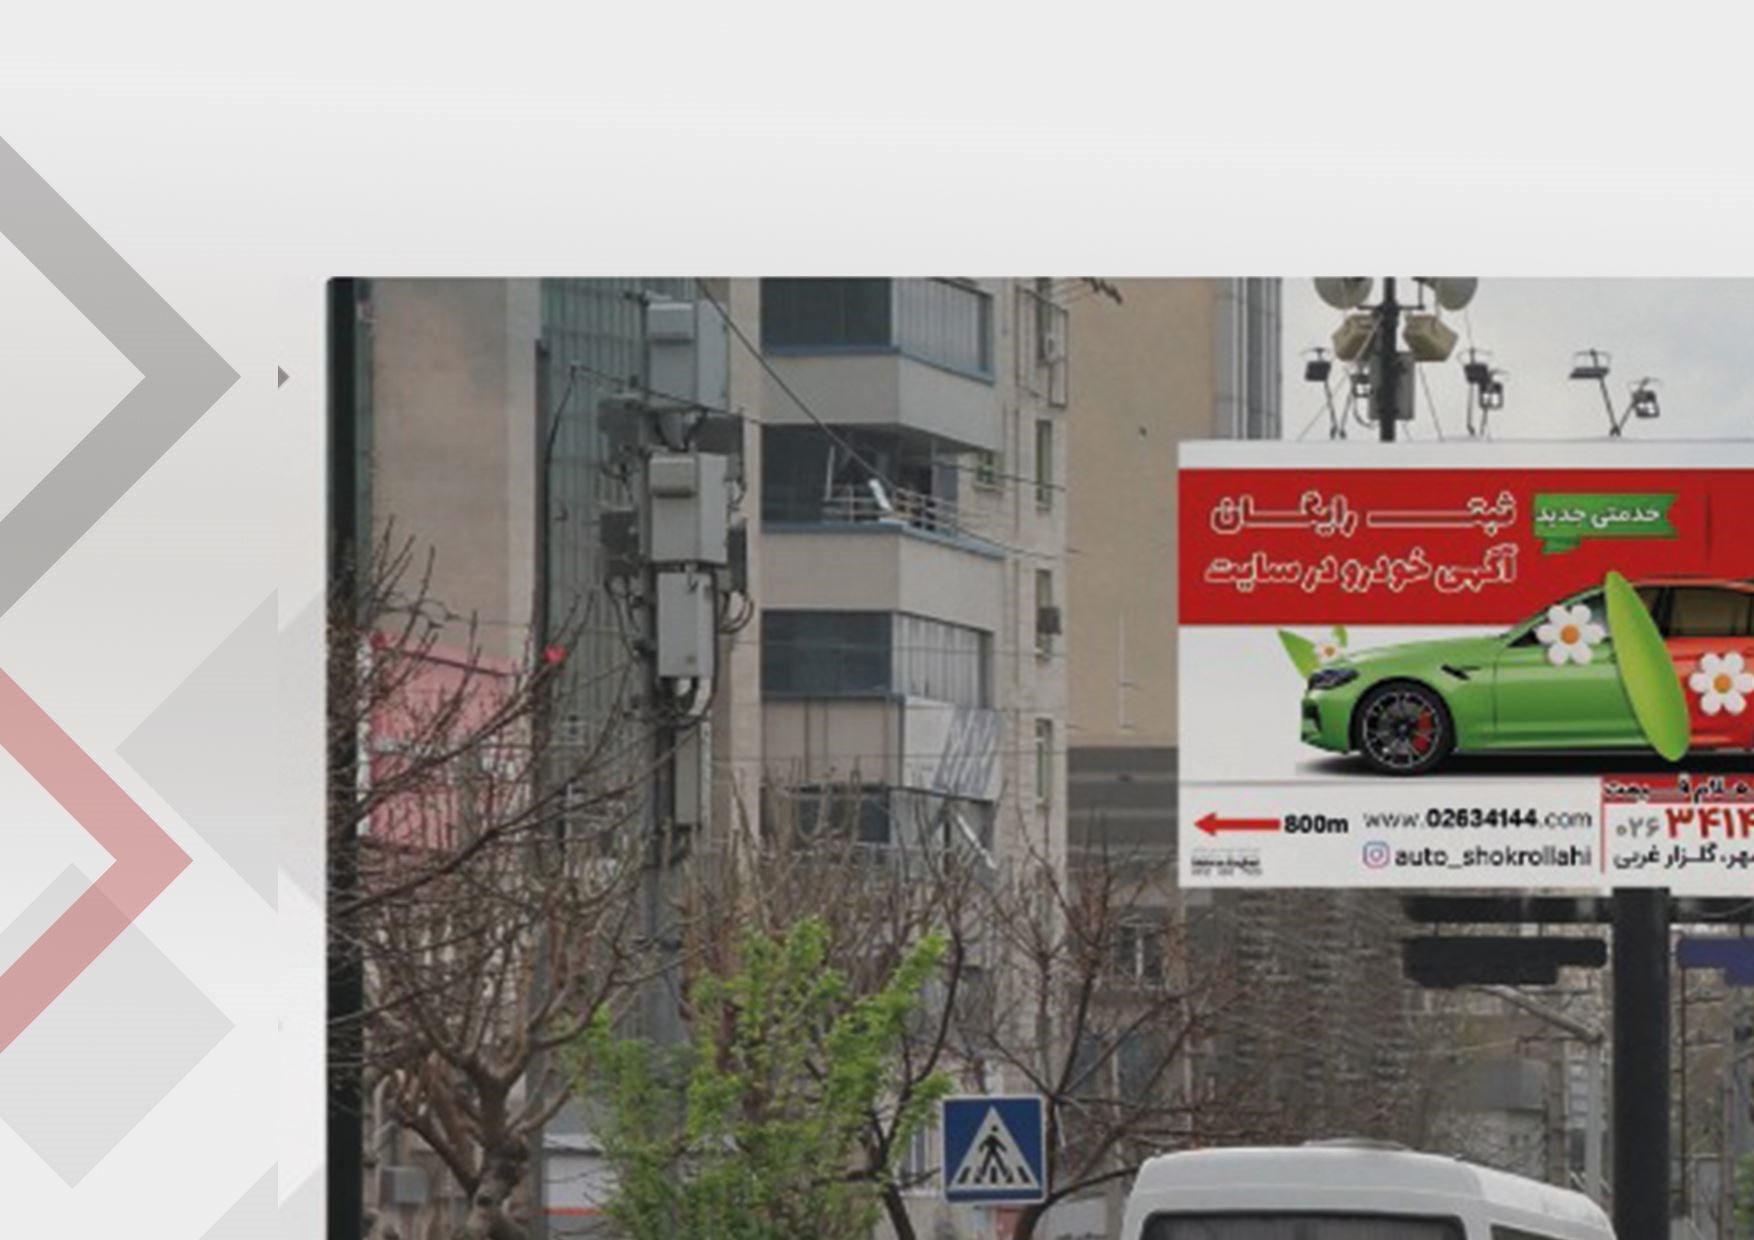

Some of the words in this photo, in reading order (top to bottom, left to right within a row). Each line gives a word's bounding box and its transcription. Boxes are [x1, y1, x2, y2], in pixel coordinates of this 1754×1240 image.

[1211, 491, 1358, 537] رایگان
[1367, 492, 1517, 536] ثبت
[1535, 505, 1586, 529] جدید
[1590, 502, 1661, 529] خدمتی
[1204, 551, 1301, 593] سایت
[1302, 559, 1338, 592] در
[1341, 547, 1430, 593] خودرو
[1435, 543, 1518, 593] آگهی
[1284, 814, 1349, 834] 800m
[1362, 807, 1593, 829] www.02634144.com
[1394, 841, 1593, 870] auto_shokrollahi
[1613, 844, 1661, 870] غربی
[1664, 842, 1718, 869] گلزار
